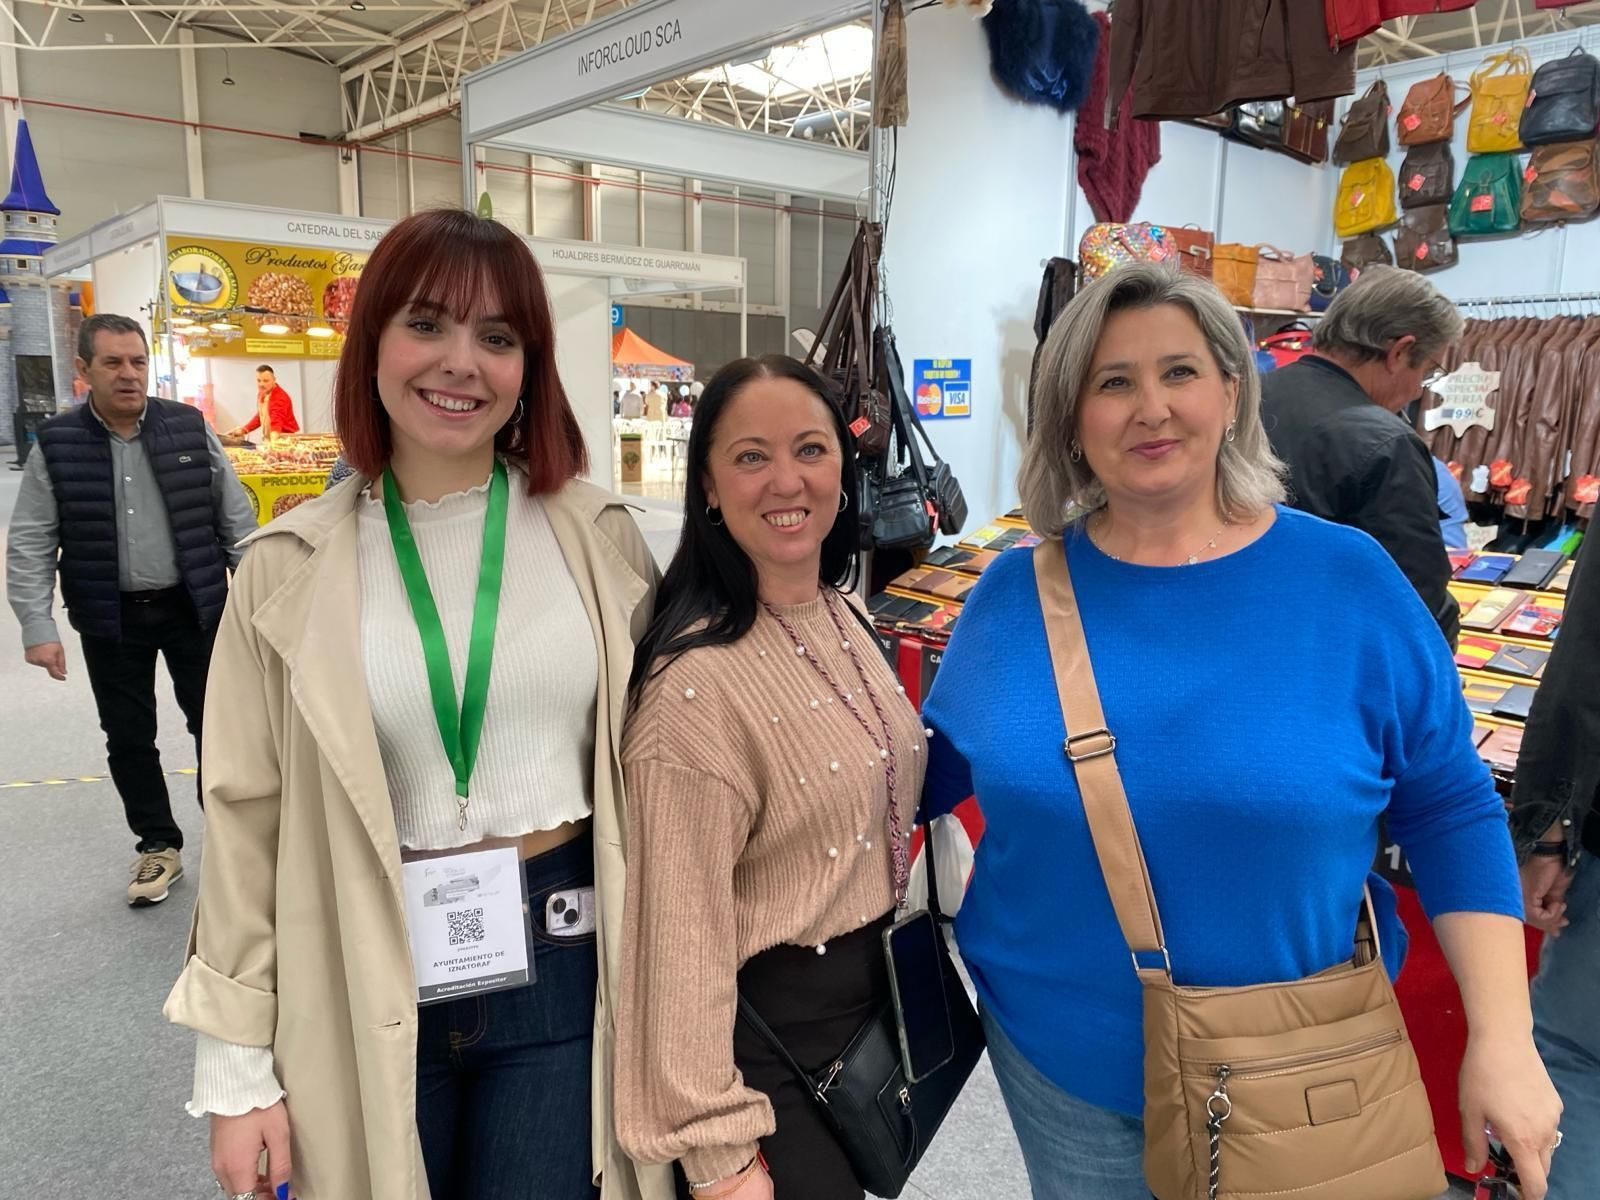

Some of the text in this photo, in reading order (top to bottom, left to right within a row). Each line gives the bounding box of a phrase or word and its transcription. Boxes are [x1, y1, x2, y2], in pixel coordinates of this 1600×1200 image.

[578, 18, 682, 76] INFORCLOUD SCA
[287, 222, 340, 237] CATEDRAL
[343, 228, 362, 240] DEL
[245, 247, 327, 270] Productos
[552, 249, 701, 272] HOJALDRES BERMÚDEZ DE GUARROMÁN
[949, 392, 966, 405] VISA
[433, 952, 493, 967] AYUNTAMIENTO
[448, 961, 491, 972] IZNATORAF
[436, 976, 508, 993] Acreditación Expositor
